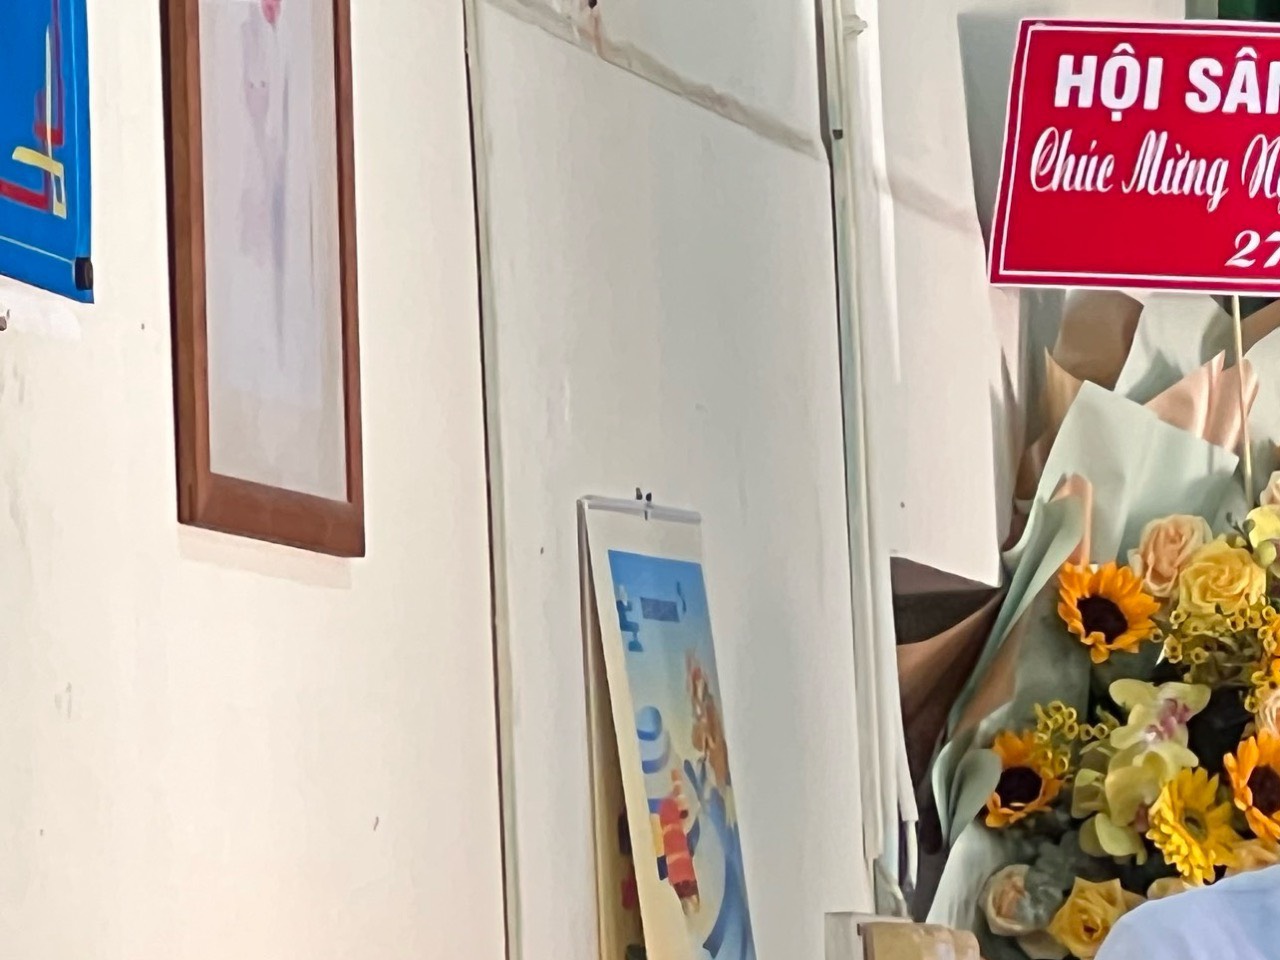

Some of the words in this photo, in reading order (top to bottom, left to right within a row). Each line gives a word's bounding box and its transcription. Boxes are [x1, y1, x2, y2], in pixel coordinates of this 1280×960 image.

[1053, 42, 1164, 122] HỘI
[1029, 126, 1115, 193] Chúc
[1121, 129, 1230, 213] Mừng
